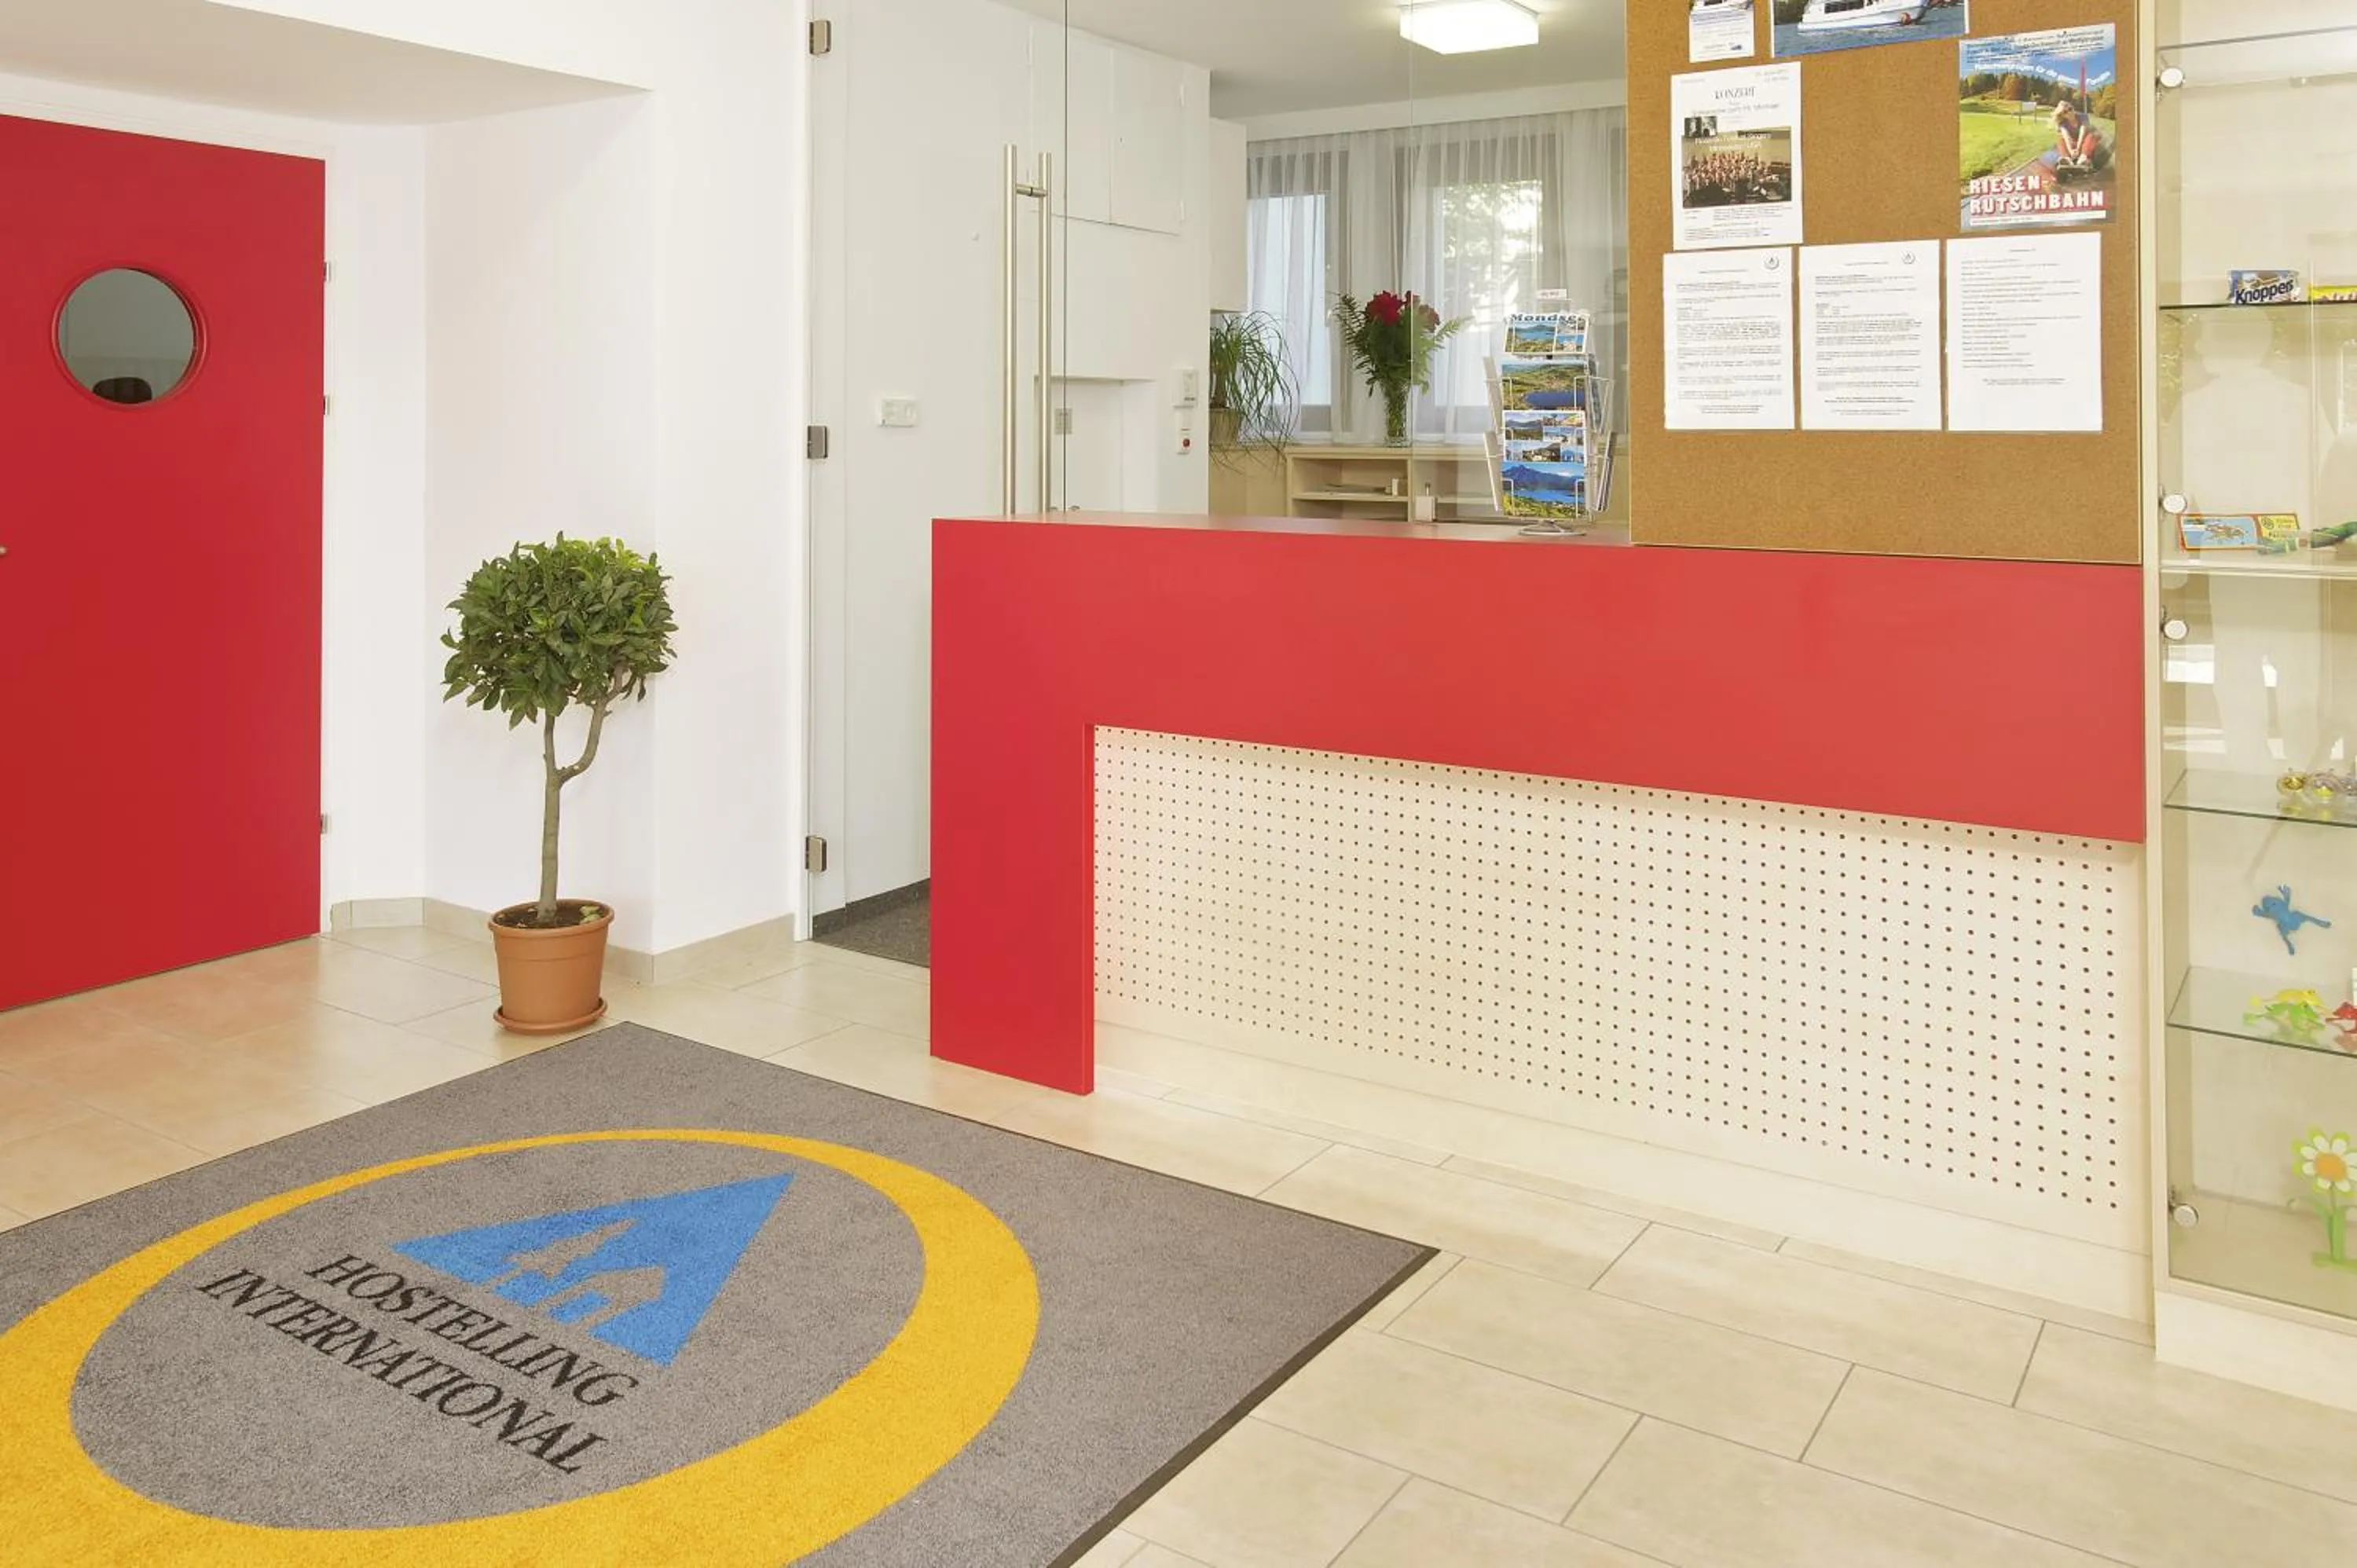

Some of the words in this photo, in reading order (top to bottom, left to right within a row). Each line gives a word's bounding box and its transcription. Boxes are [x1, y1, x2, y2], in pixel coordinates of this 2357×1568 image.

[1970, 190, 2105, 215] RUTSCHBAHN
[2235, 279, 2294, 305] Knoppers
[196, 1268, 607, 1475] INTERNATIONAL
[303, 1253, 638, 1407] HOSTELLING
